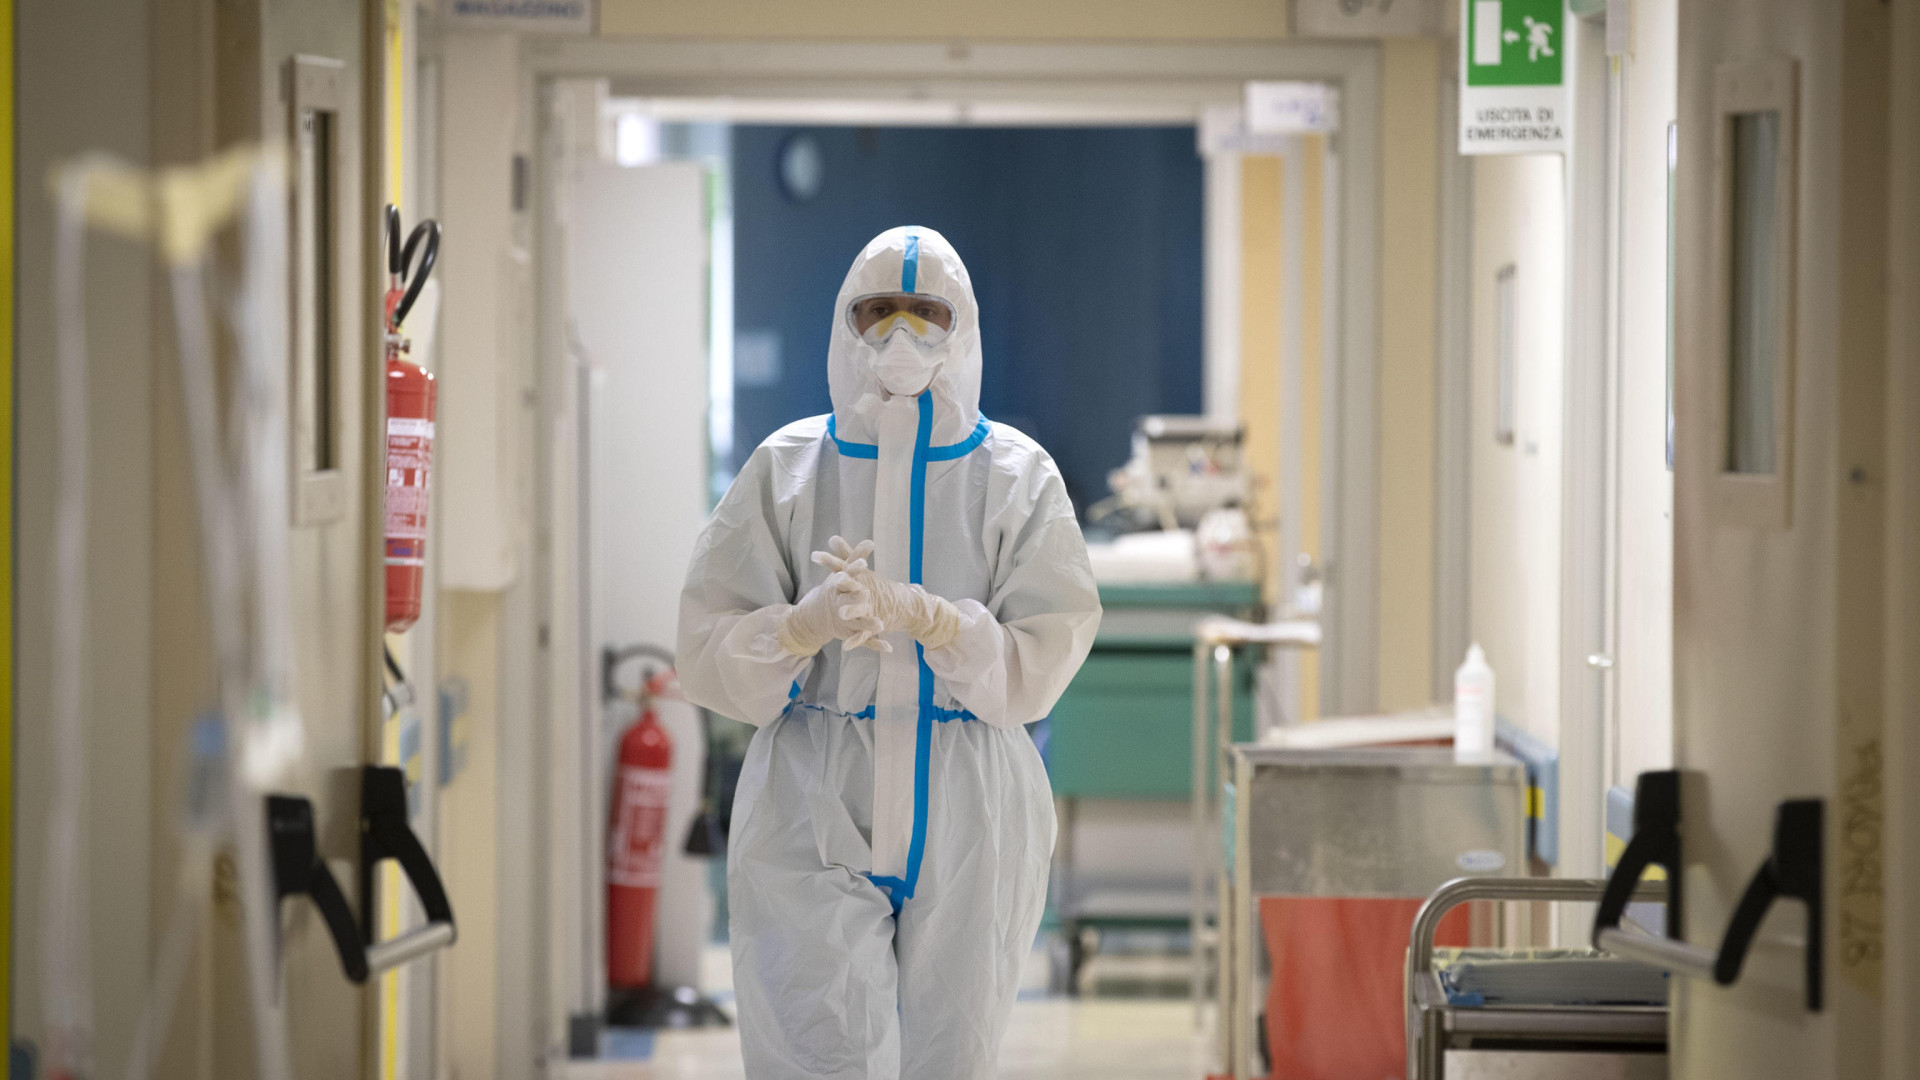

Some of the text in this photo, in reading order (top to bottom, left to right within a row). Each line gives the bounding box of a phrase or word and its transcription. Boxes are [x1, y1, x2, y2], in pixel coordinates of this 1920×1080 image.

[1476, 106, 1554, 122] USCITA DI
[1466, 126, 1564, 140] EMERGENZA
